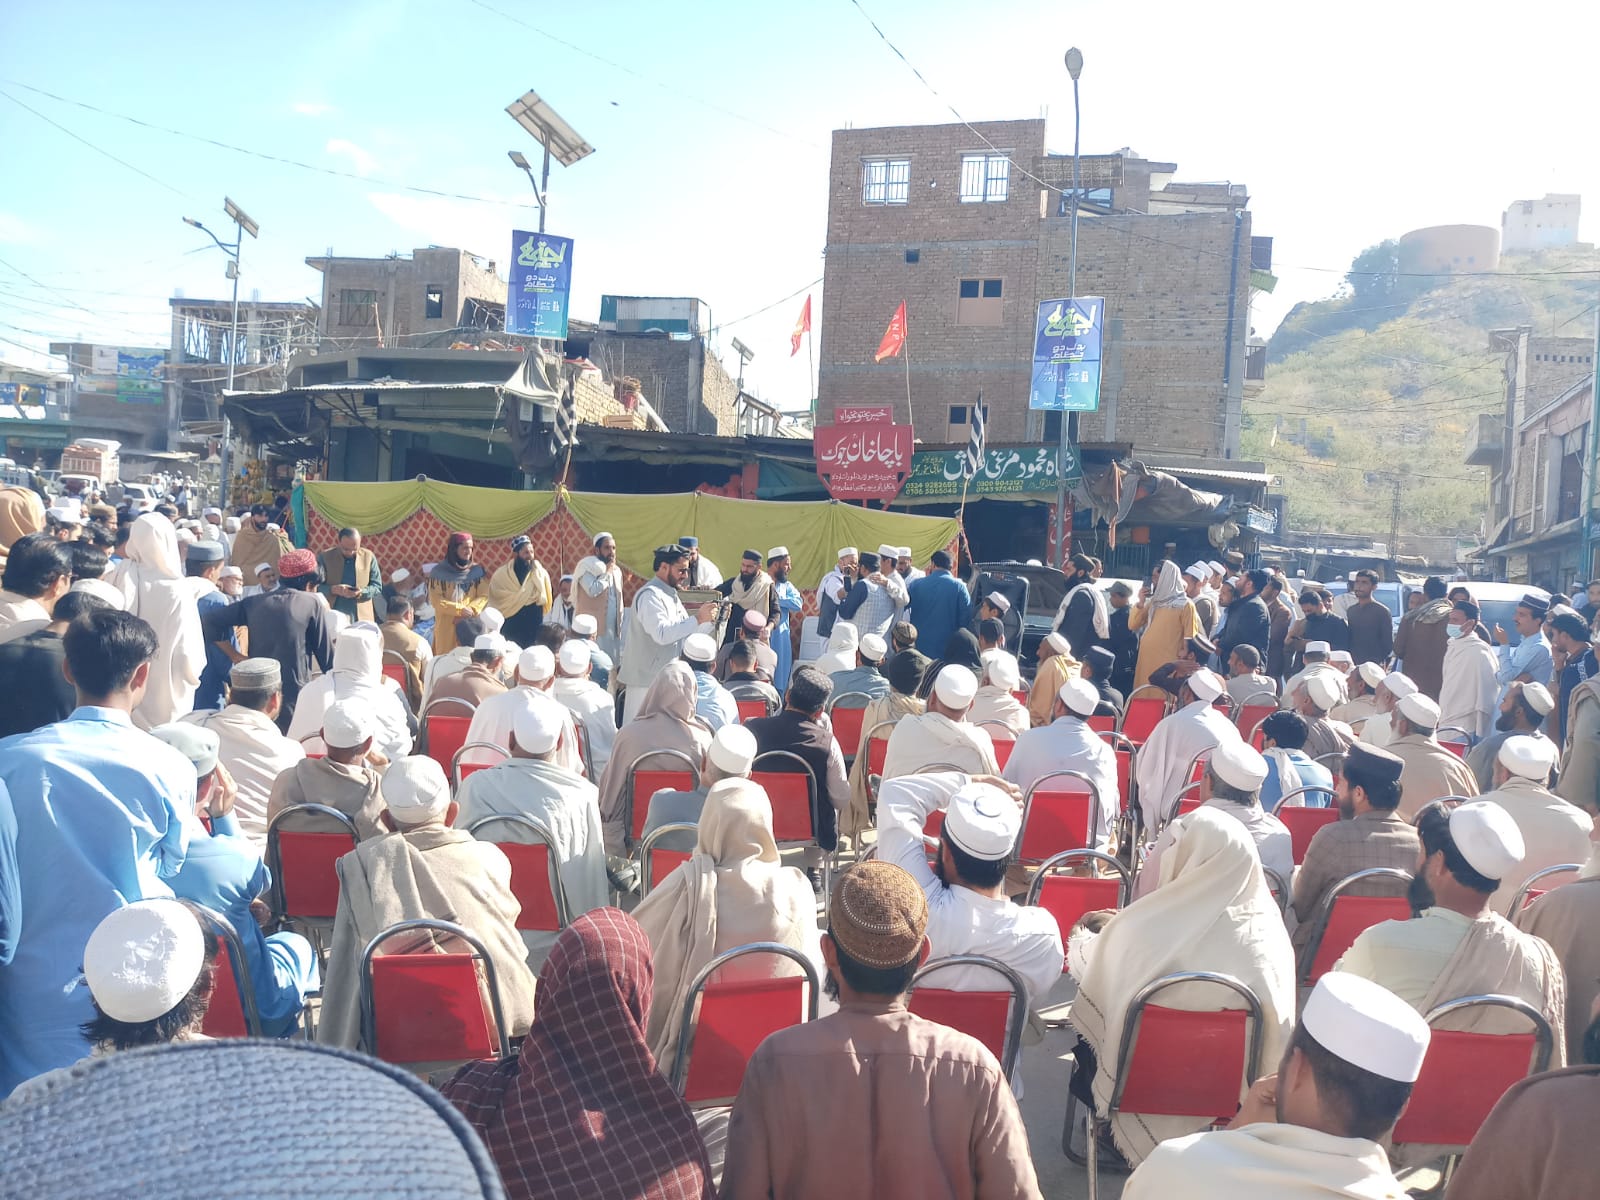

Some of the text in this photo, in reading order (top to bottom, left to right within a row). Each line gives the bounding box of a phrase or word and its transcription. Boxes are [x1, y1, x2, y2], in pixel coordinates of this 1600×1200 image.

[821, 431, 904, 468] باچا خان چوک
[1016, 448, 1047, 478] محمود
